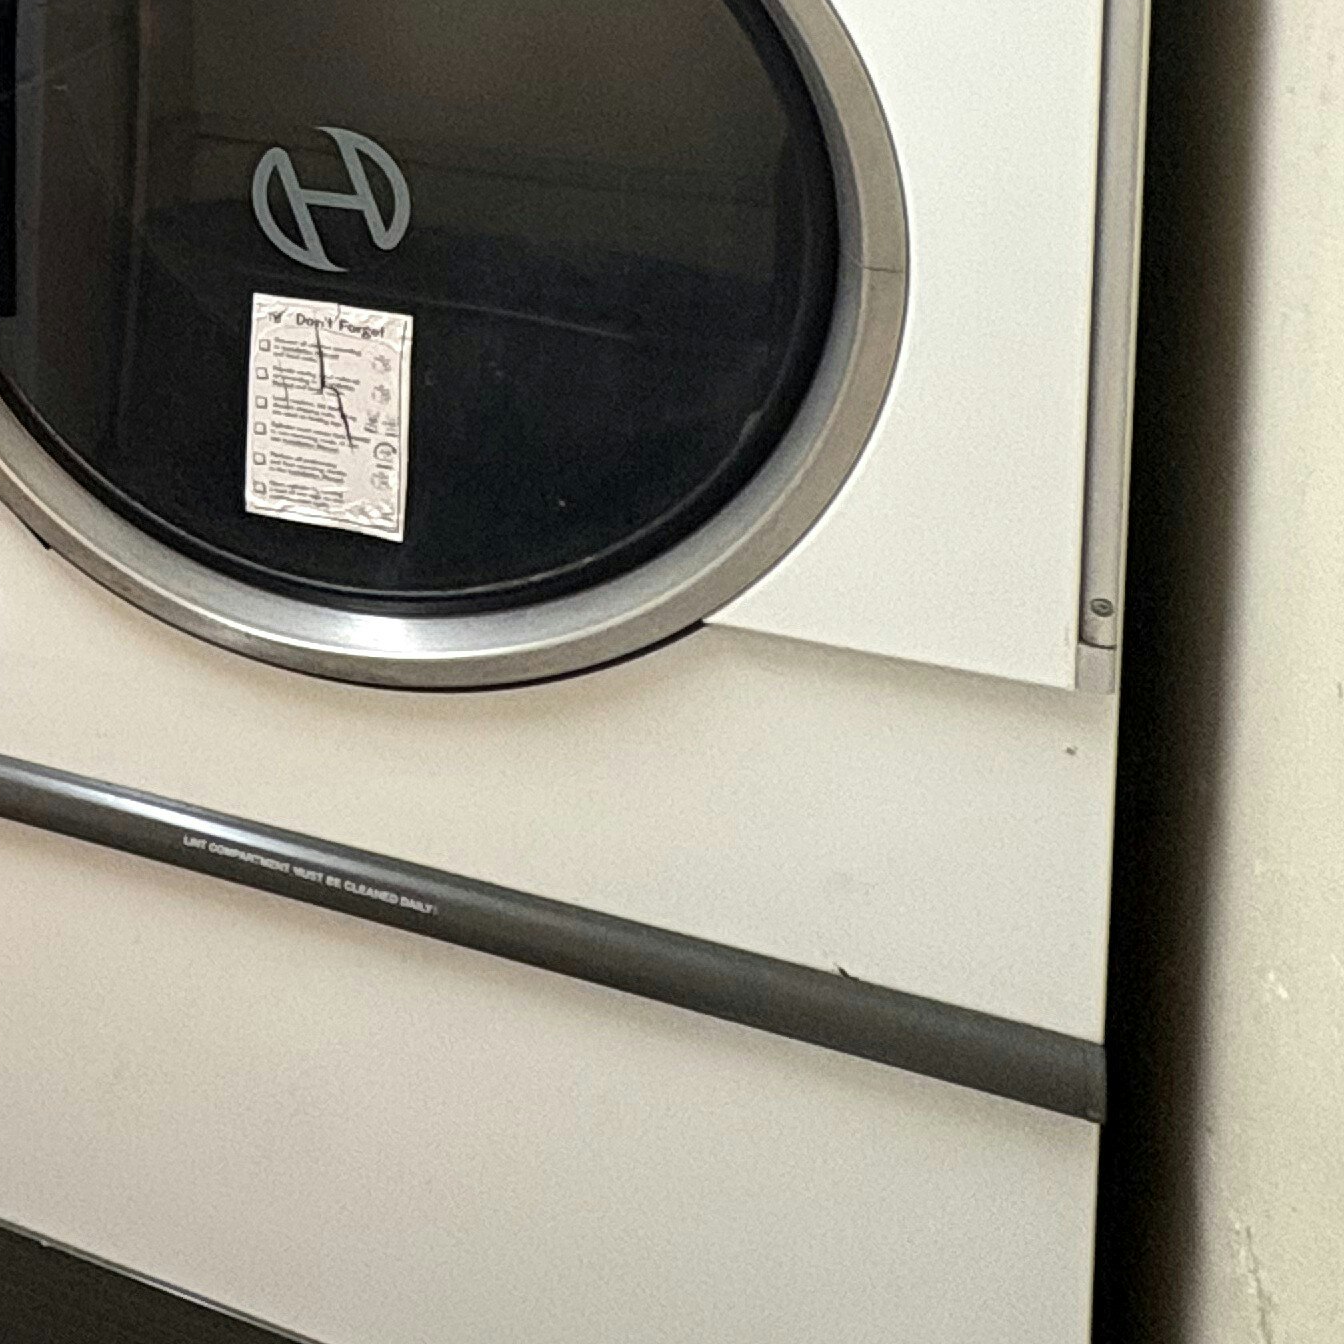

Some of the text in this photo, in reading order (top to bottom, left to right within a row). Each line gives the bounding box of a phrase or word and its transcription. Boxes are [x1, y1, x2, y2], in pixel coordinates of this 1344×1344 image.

[293, 866, 324, 883] MUST
[326, 875, 342, 889] BE
[344, 880, 399, 904] CLEANED
